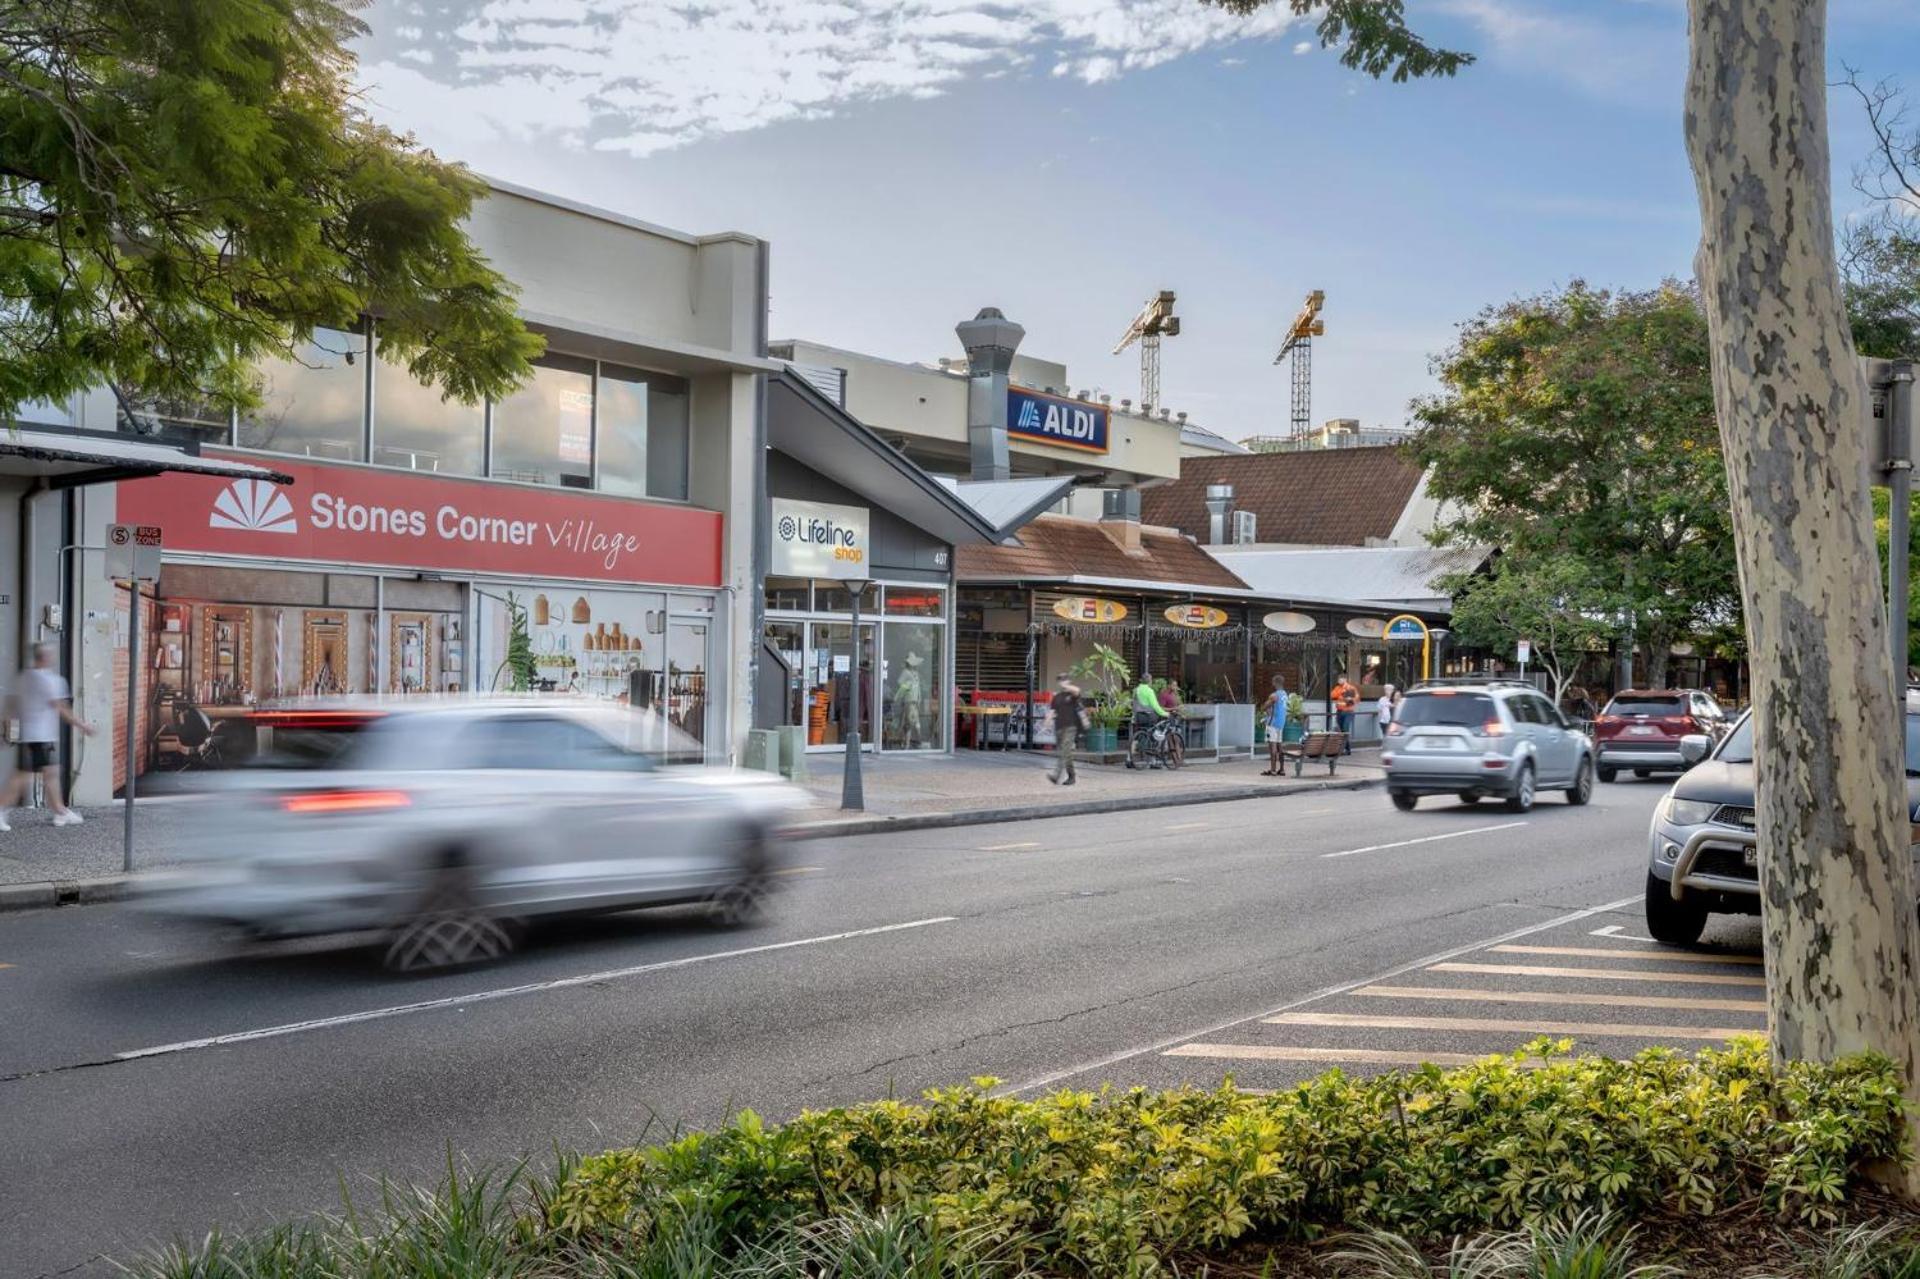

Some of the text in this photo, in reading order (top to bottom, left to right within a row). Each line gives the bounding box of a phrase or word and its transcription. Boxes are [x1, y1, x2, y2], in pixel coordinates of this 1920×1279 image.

[1043, 404, 1095, 440] ALDI
[136, 536, 161, 545] ZONE
[139, 528, 158, 536] BUS
[310, 492, 641, 570] Stones Corner Village
[798, 516, 855, 547] Lifeline
